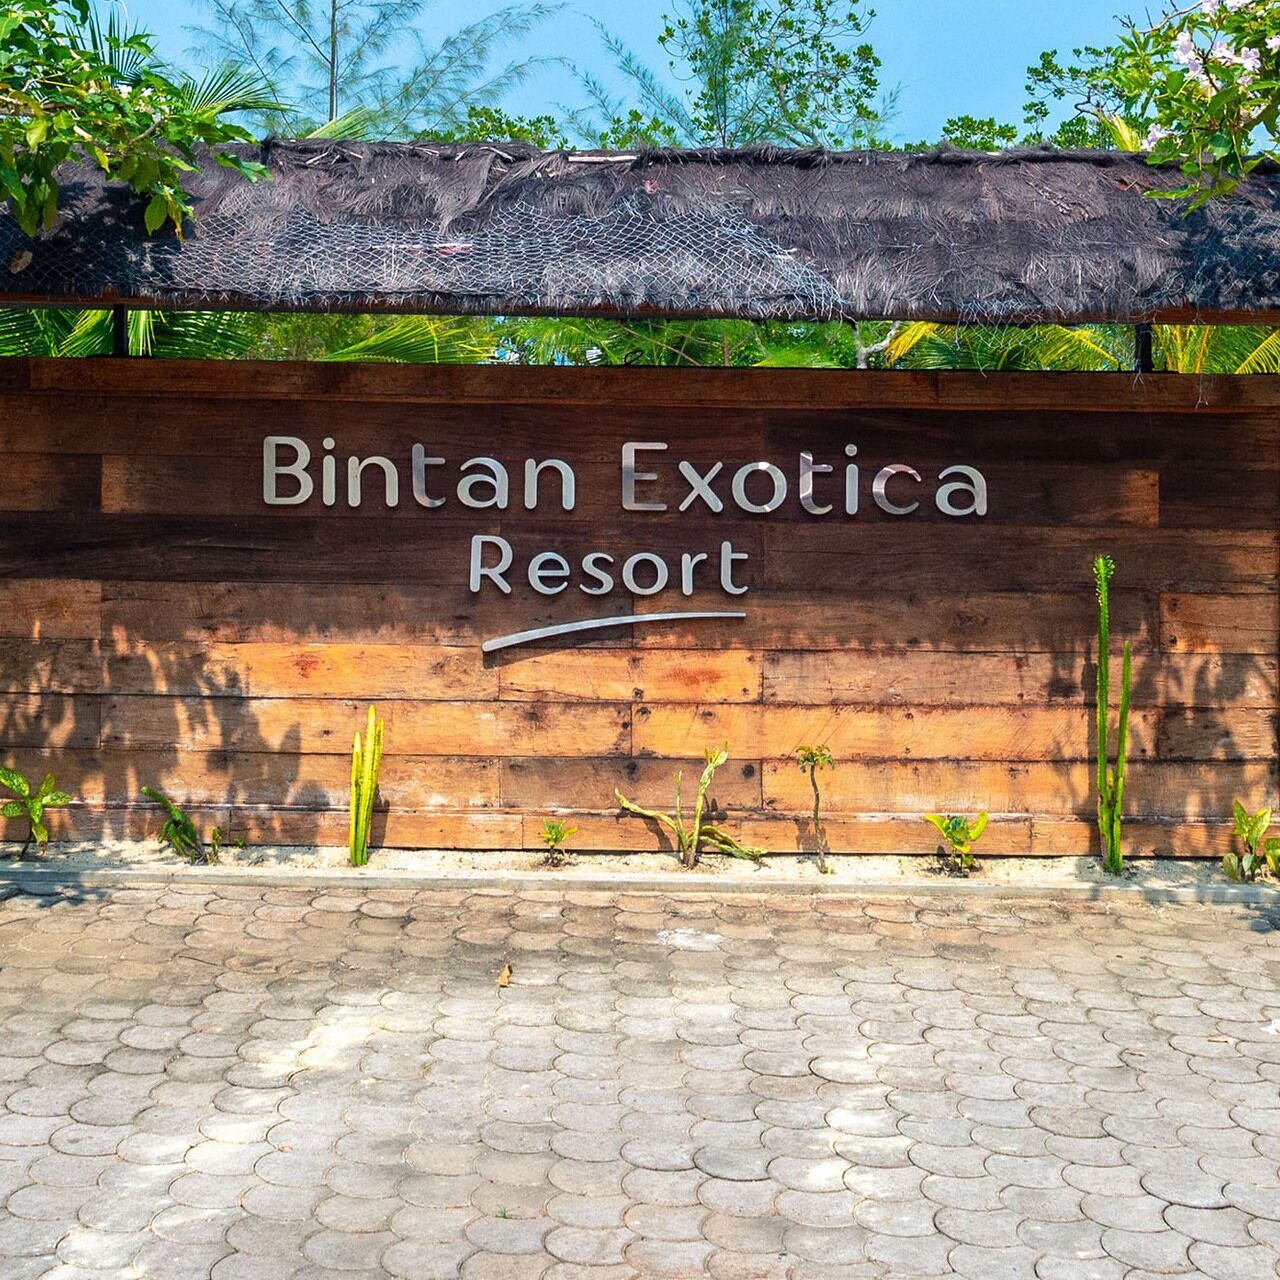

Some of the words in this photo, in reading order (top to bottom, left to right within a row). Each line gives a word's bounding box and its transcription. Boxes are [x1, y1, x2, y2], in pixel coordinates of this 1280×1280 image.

[262, 435, 576, 511] Bintan
[620, 440, 988, 516] Exotica
[468, 533, 749, 596] Resort
